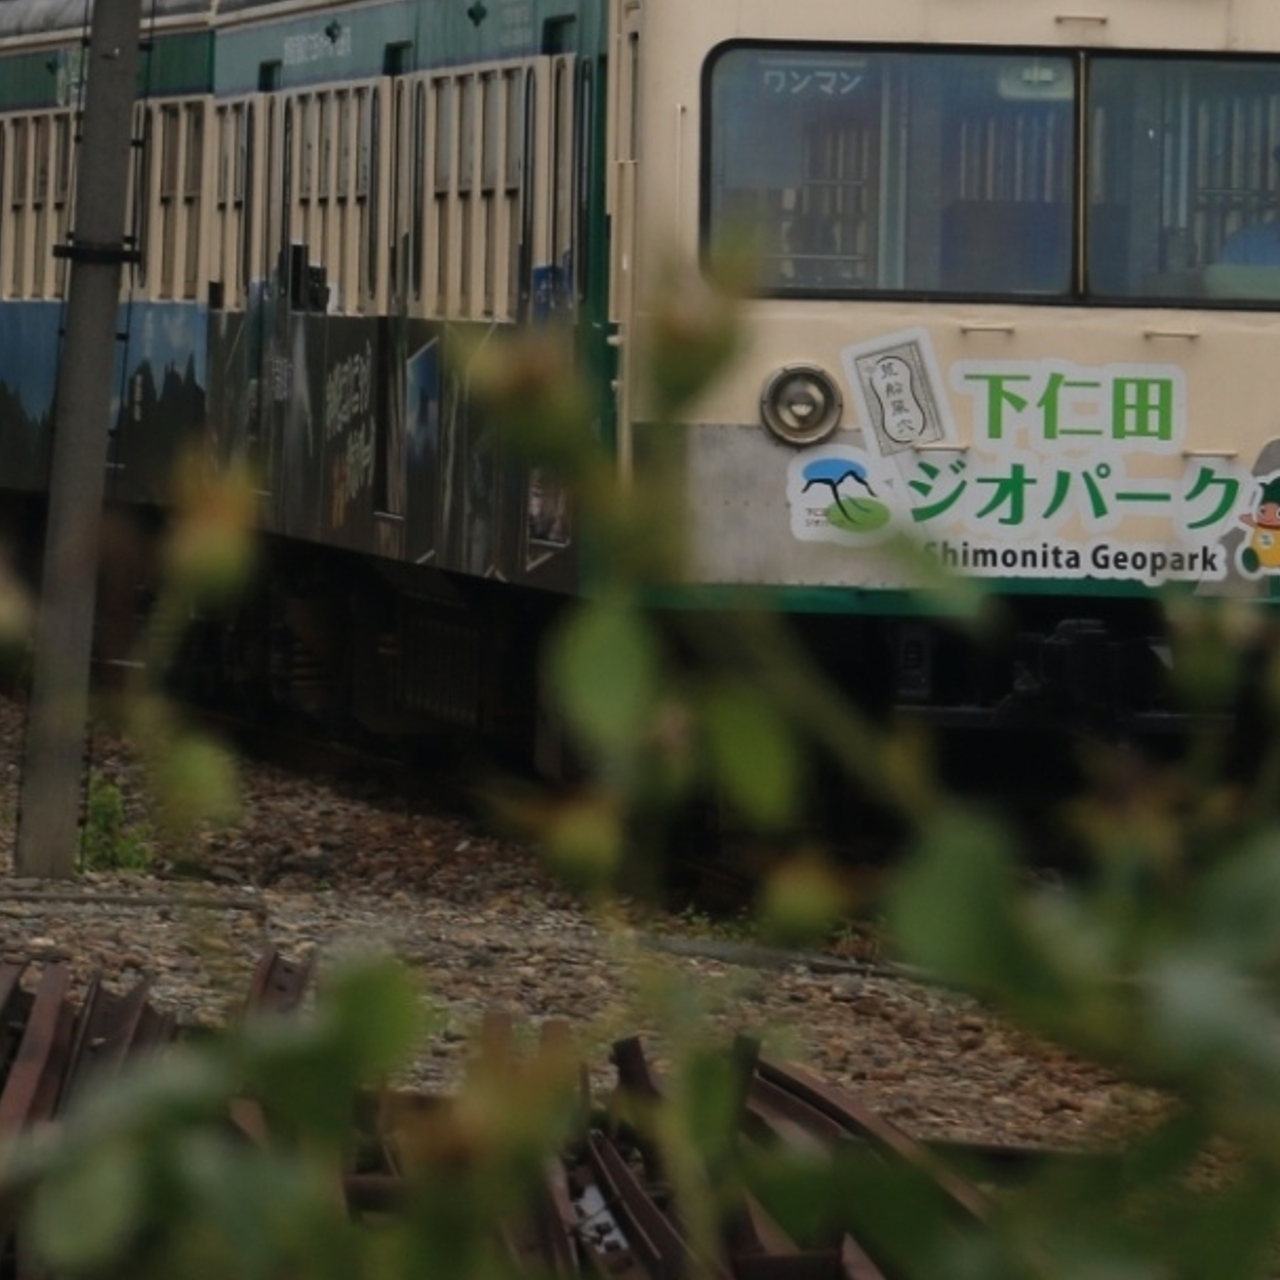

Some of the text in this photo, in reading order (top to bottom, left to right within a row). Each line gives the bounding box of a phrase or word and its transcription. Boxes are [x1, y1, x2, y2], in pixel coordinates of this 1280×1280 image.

[762, 69, 864, 96] ワンマン
[963, 371, 1174, 441] 下仁田
[907, 460, 1240, 531] ジオパーク
[1091, 544, 1218, 577] Geopark
